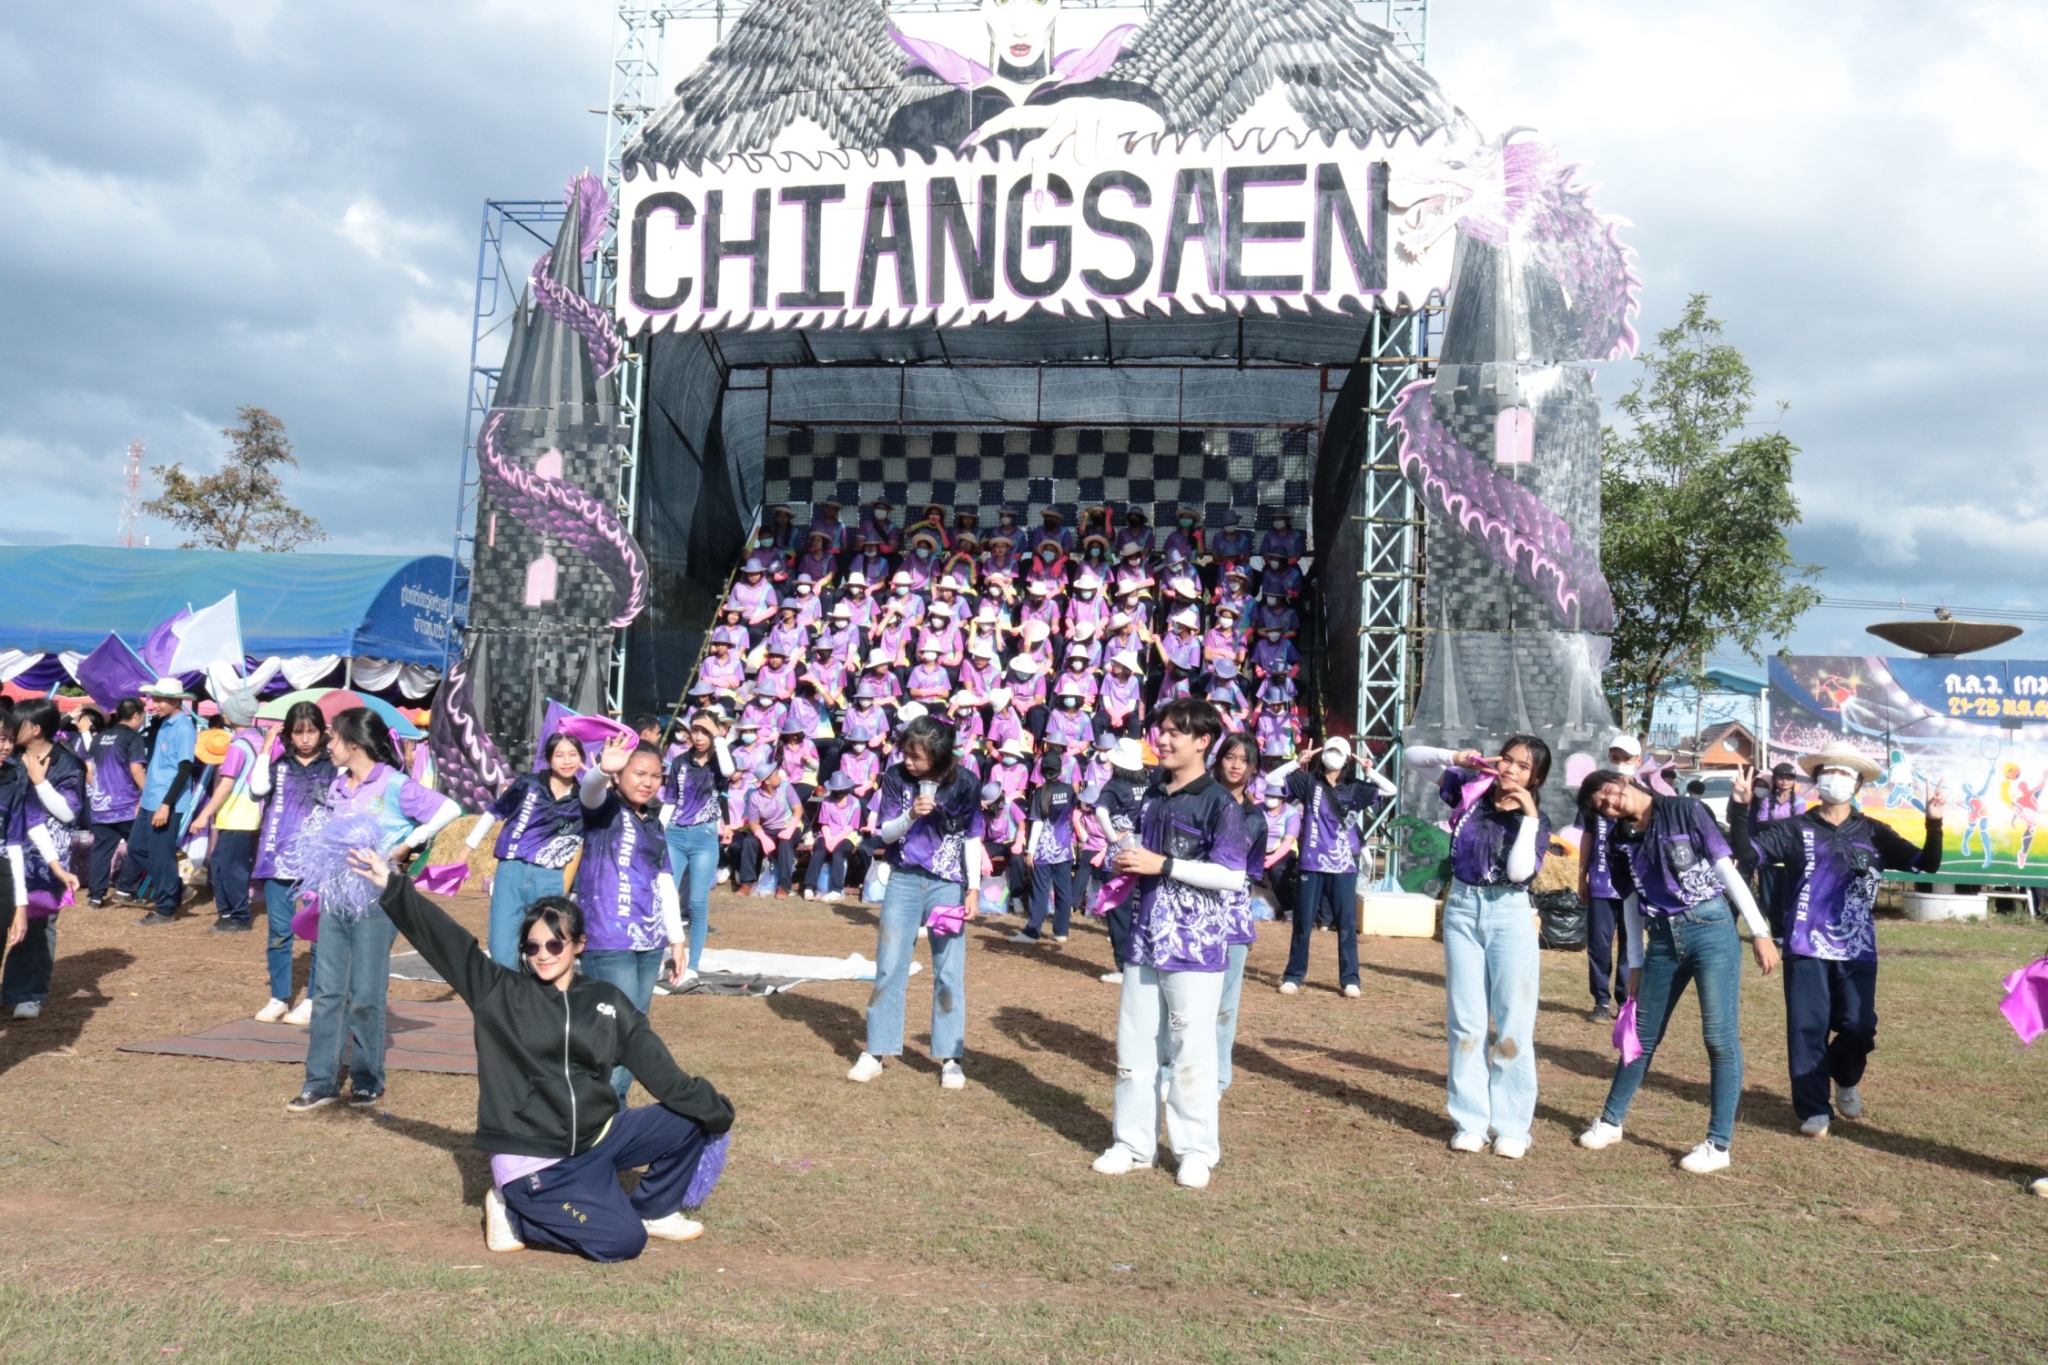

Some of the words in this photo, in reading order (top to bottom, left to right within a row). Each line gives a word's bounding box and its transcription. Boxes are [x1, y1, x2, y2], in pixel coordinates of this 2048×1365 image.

[629, 161, 1389, 314] CHIANGSAEN
[1945, 674, 2004, 695] ก.ล.ว.
[1948, 696, 2001, 717] 21-25
[512, 792, 537, 840] CHIANG
[618, 871, 632, 917] SAEN
[1796, 883, 1811, 921] SAEN
